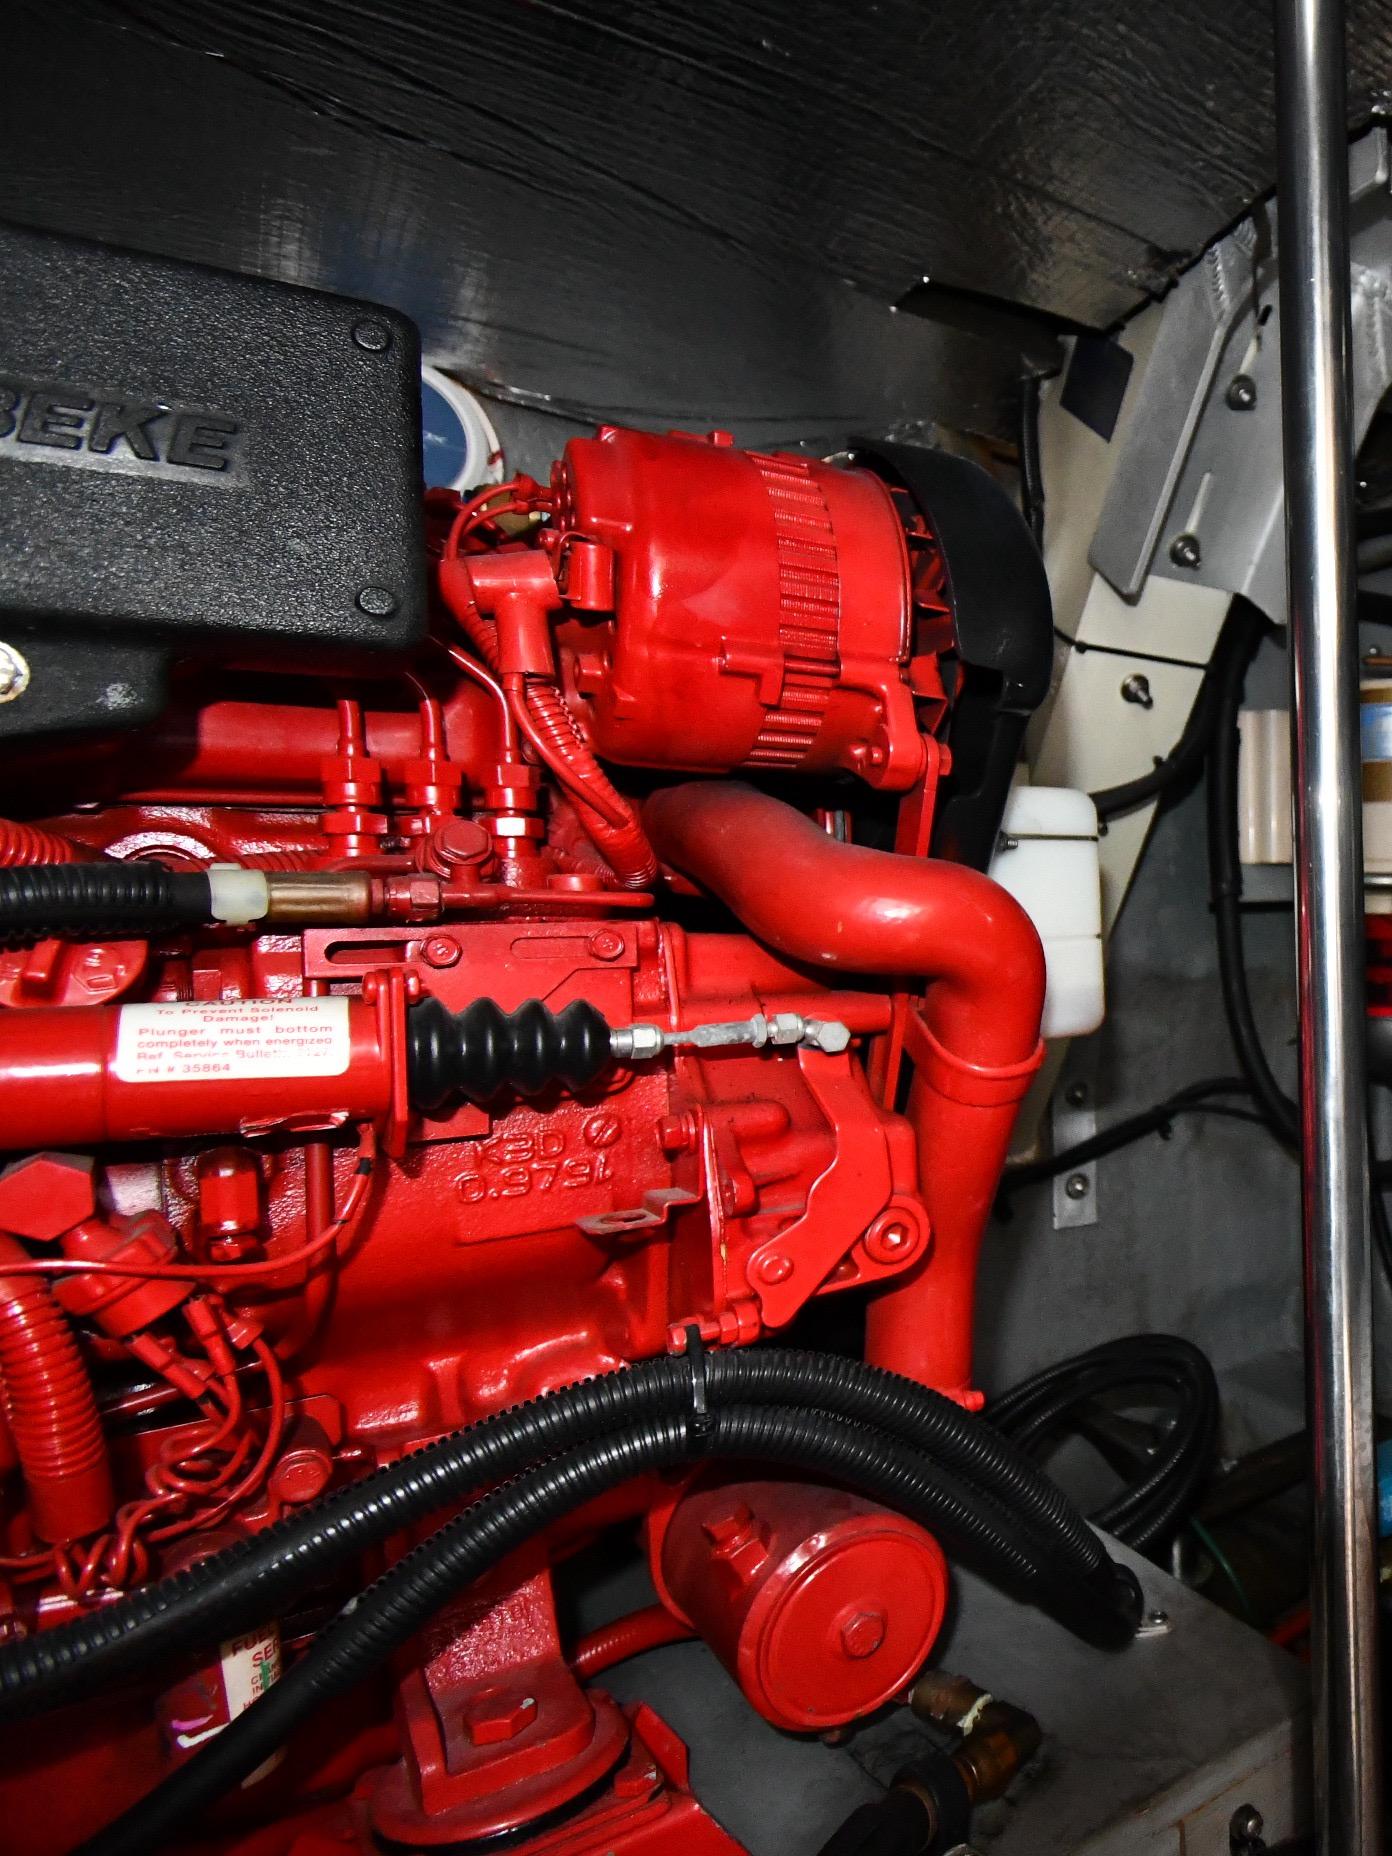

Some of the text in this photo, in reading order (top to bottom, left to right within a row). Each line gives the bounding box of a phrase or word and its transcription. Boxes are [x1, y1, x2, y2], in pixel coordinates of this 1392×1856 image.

[250, 1005, 319, 1013] Solenoid
[203, 1014, 274, 1022] Damage!
[138, 1025, 333, 1037] Plunger must bottom
[137, 1039, 217, 1049] completely
[223, 1038, 260, 1047] when
[183, 1063, 231, 1074] 35864
